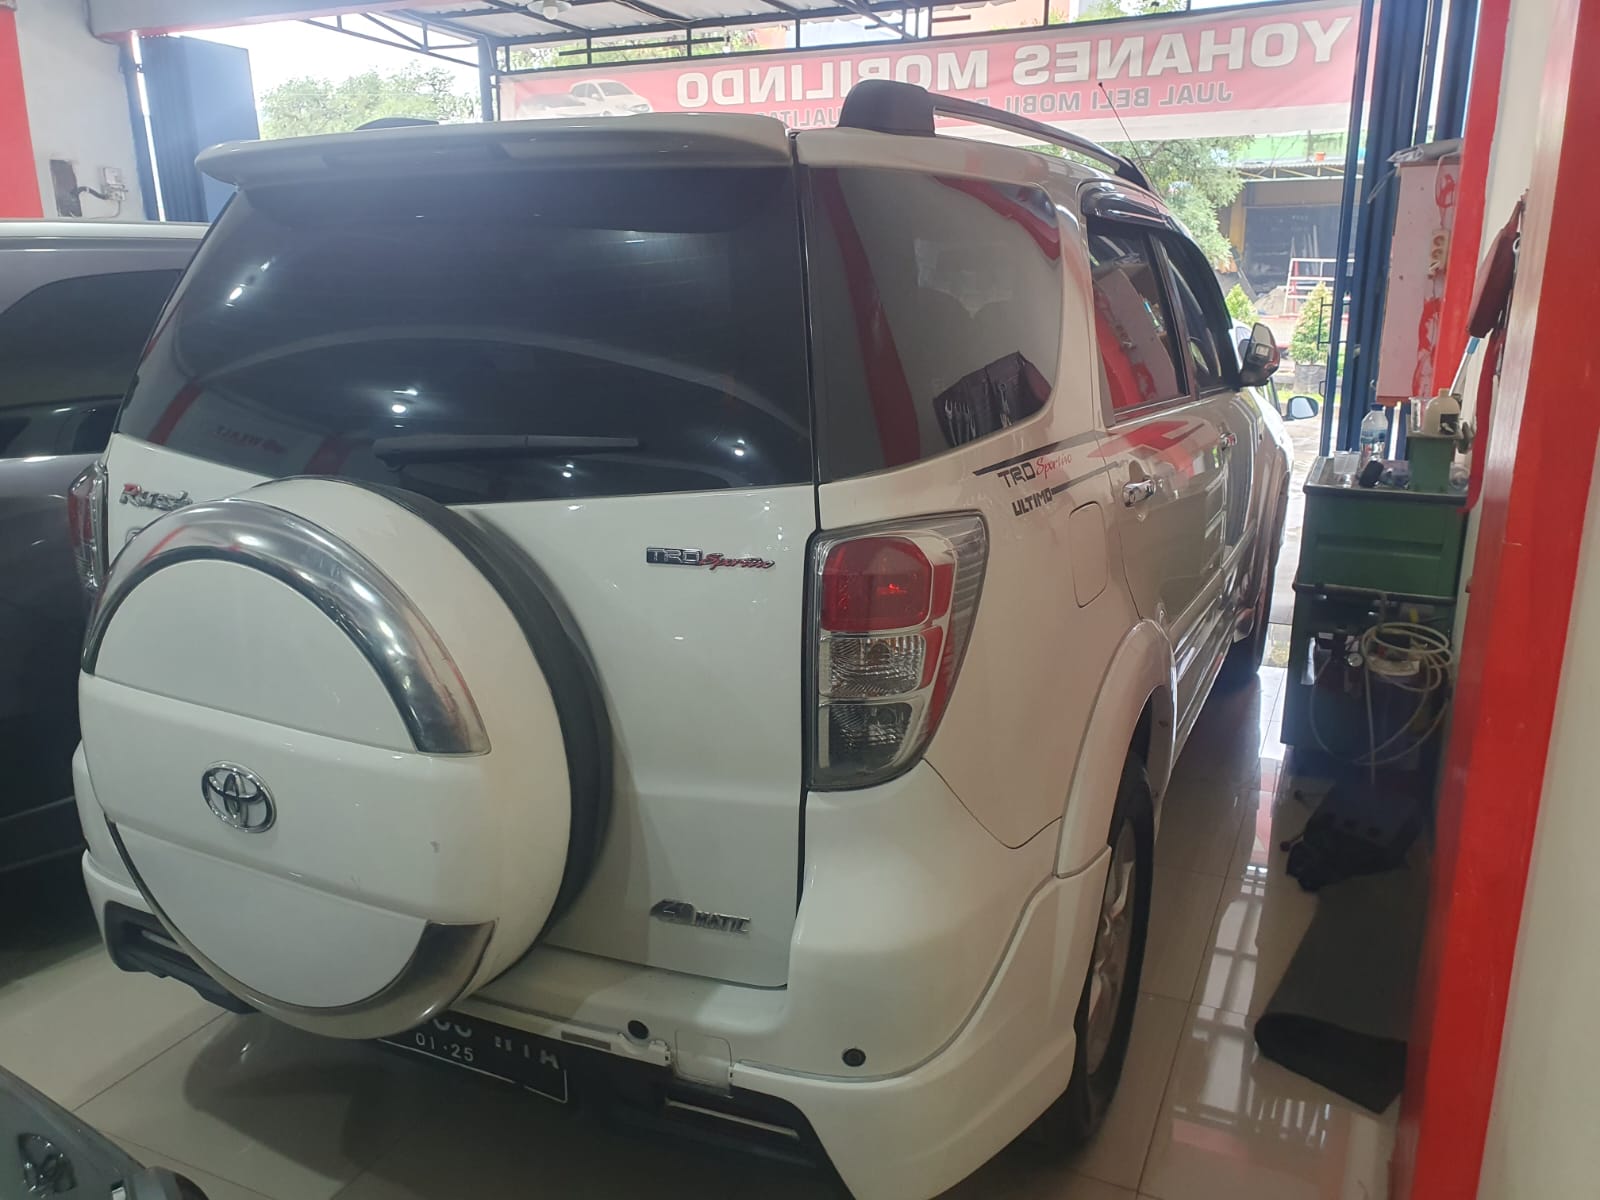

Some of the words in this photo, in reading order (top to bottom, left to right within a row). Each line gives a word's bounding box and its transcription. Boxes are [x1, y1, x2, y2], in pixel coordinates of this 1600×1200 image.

[997, 462, 1036, 488] TRD
[1035, 453, 1072, 479] Sportivo
[1012, 487, 1053, 516] ULTIMO
[647, 548, 703, 566] TRD
[700, 553, 776, 570] Sportivo
[695, 911, 751, 934] MATIC
